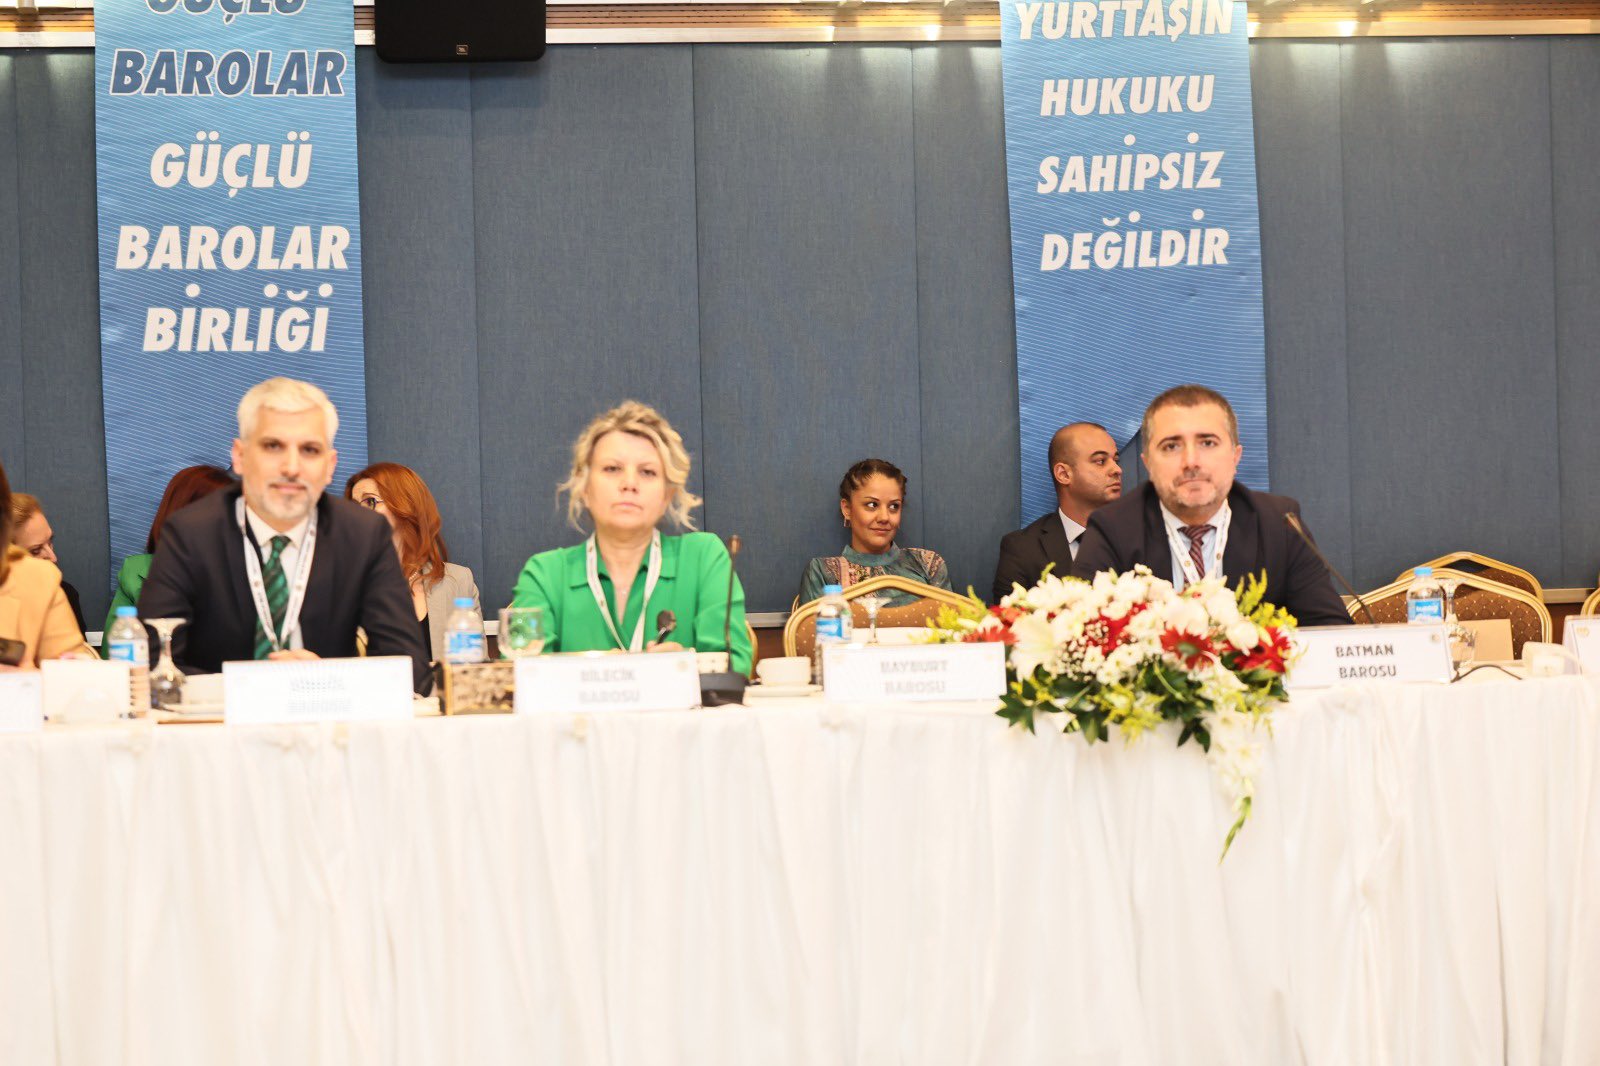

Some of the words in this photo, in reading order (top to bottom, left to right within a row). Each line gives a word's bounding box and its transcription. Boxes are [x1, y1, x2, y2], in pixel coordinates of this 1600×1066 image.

[1015, 0, 1234, 42] YURTTAŞIN
[110, 48, 347, 97] BAROLAR
[1040, 74, 1215, 116] HUKUKU
[150, 130, 313, 198] GÜÇLÜ
[1037, 132, 1225, 194] SAHİPSİZ
[115, 225, 351, 270] BAROLAR
[1040, 208, 1230, 271] DEĞİLDİR
[142, 283, 334, 352] BİRLİĞİ
[1335, 643, 1395, 658] BATMAN
[1339, 664, 1397, 679] BAROSU
